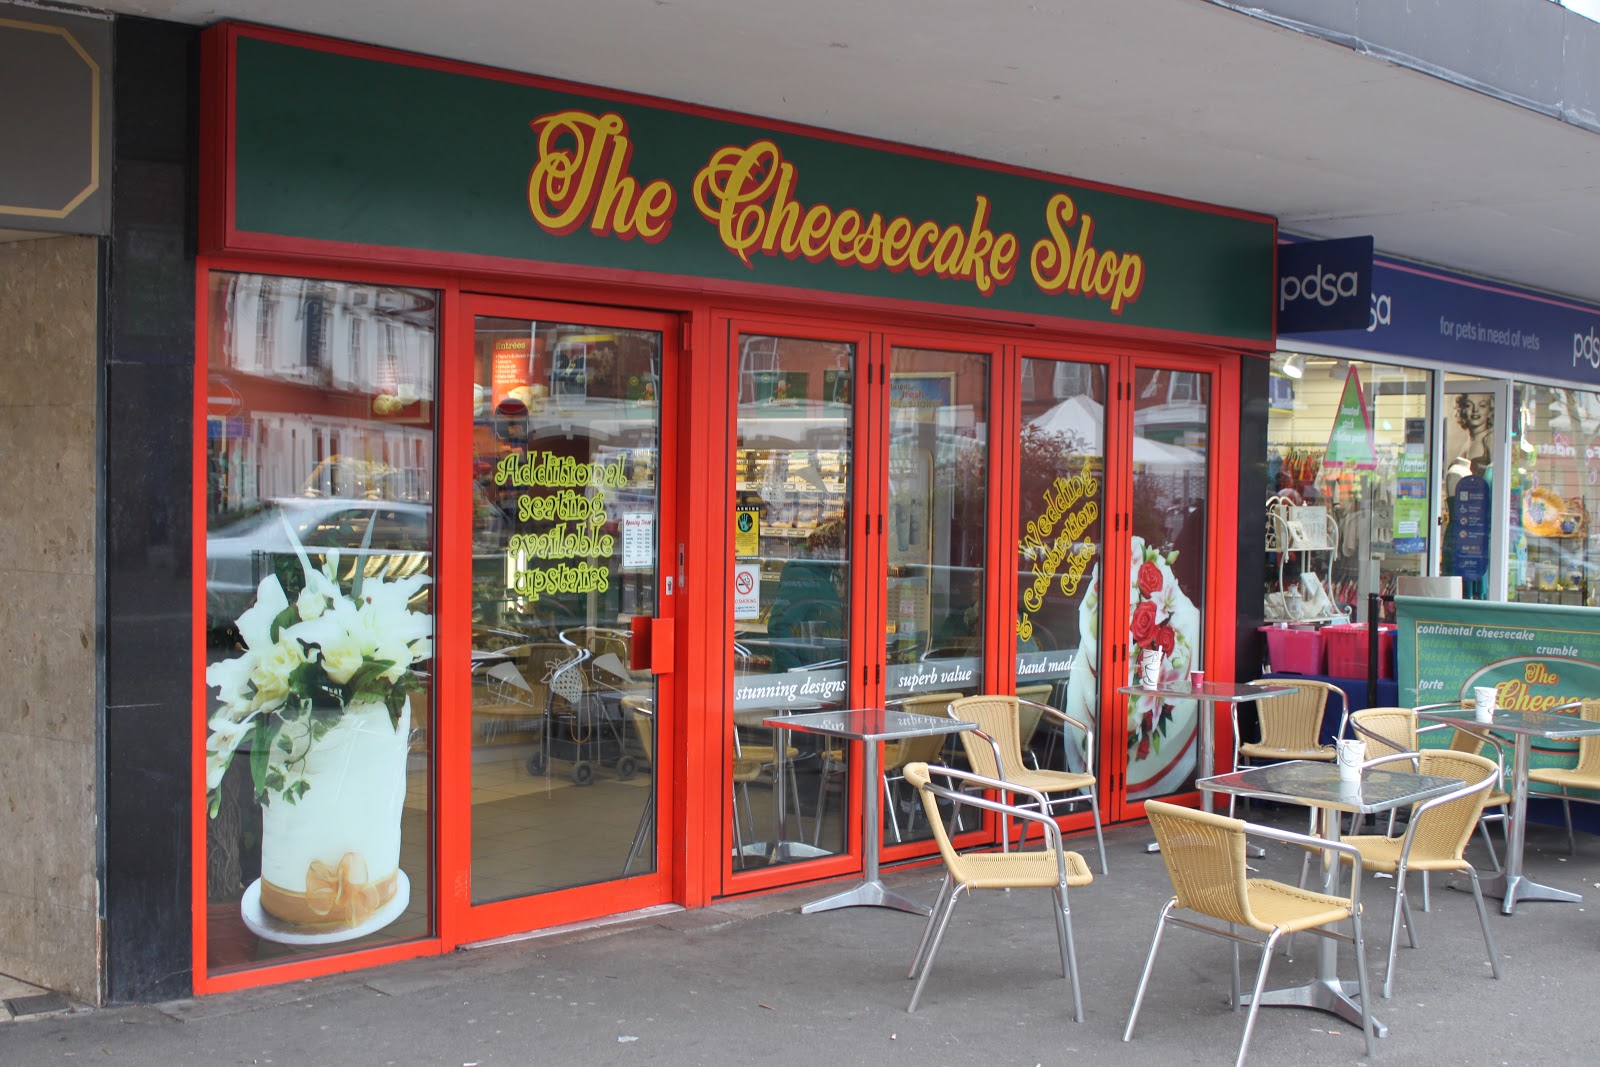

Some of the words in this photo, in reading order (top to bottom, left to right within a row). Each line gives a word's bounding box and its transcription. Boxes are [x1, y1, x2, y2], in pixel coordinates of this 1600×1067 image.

[528, 111, 677, 242] The
[693, 139, 1019, 297] Cheesecake
[1030, 193, 1145, 315] Shop
[1280, 263, 1358, 312] pdsa
[1440, 315, 1454, 336] for
[1455, 321, 1477, 341] pets
[1477, 323, 1486, 342] in
[1487, 328, 1510, 346] need
[1511, 330, 1521, 348] of
[1522, 333, 1540, 350] vets
[1573, 326, 1600, 369] pds
[495, 451, 627, 488] Additional
[1398, 458, 1427, 473] Wanted
[518, 489, 607, 526] seating
[1017, 461, 1098, 561] Wedding
[509, 522, 614, 561] available
[1024, 501, 1098, 612] Celebration
[513, 562, 609, 602] upstairs
[1060, 536, 1096, 596] Cakes
[1417, 624, 1473, 637] continental
[1476, 627, 1535, 641] cheesecake
[1536, 645, 1579, 657] crumble
[898, 667, 937, 692] superb
[940, 665, 972, 683] value
[1018, 656, 1046, 675] hand
[1048, 655, 1077, 673] made
[1524, 663, 1559, 685] The
[736, 681, 798, 702] stunning
[799, 676, 847, 699] designs
[1418, 678, 1444, 690] torte
